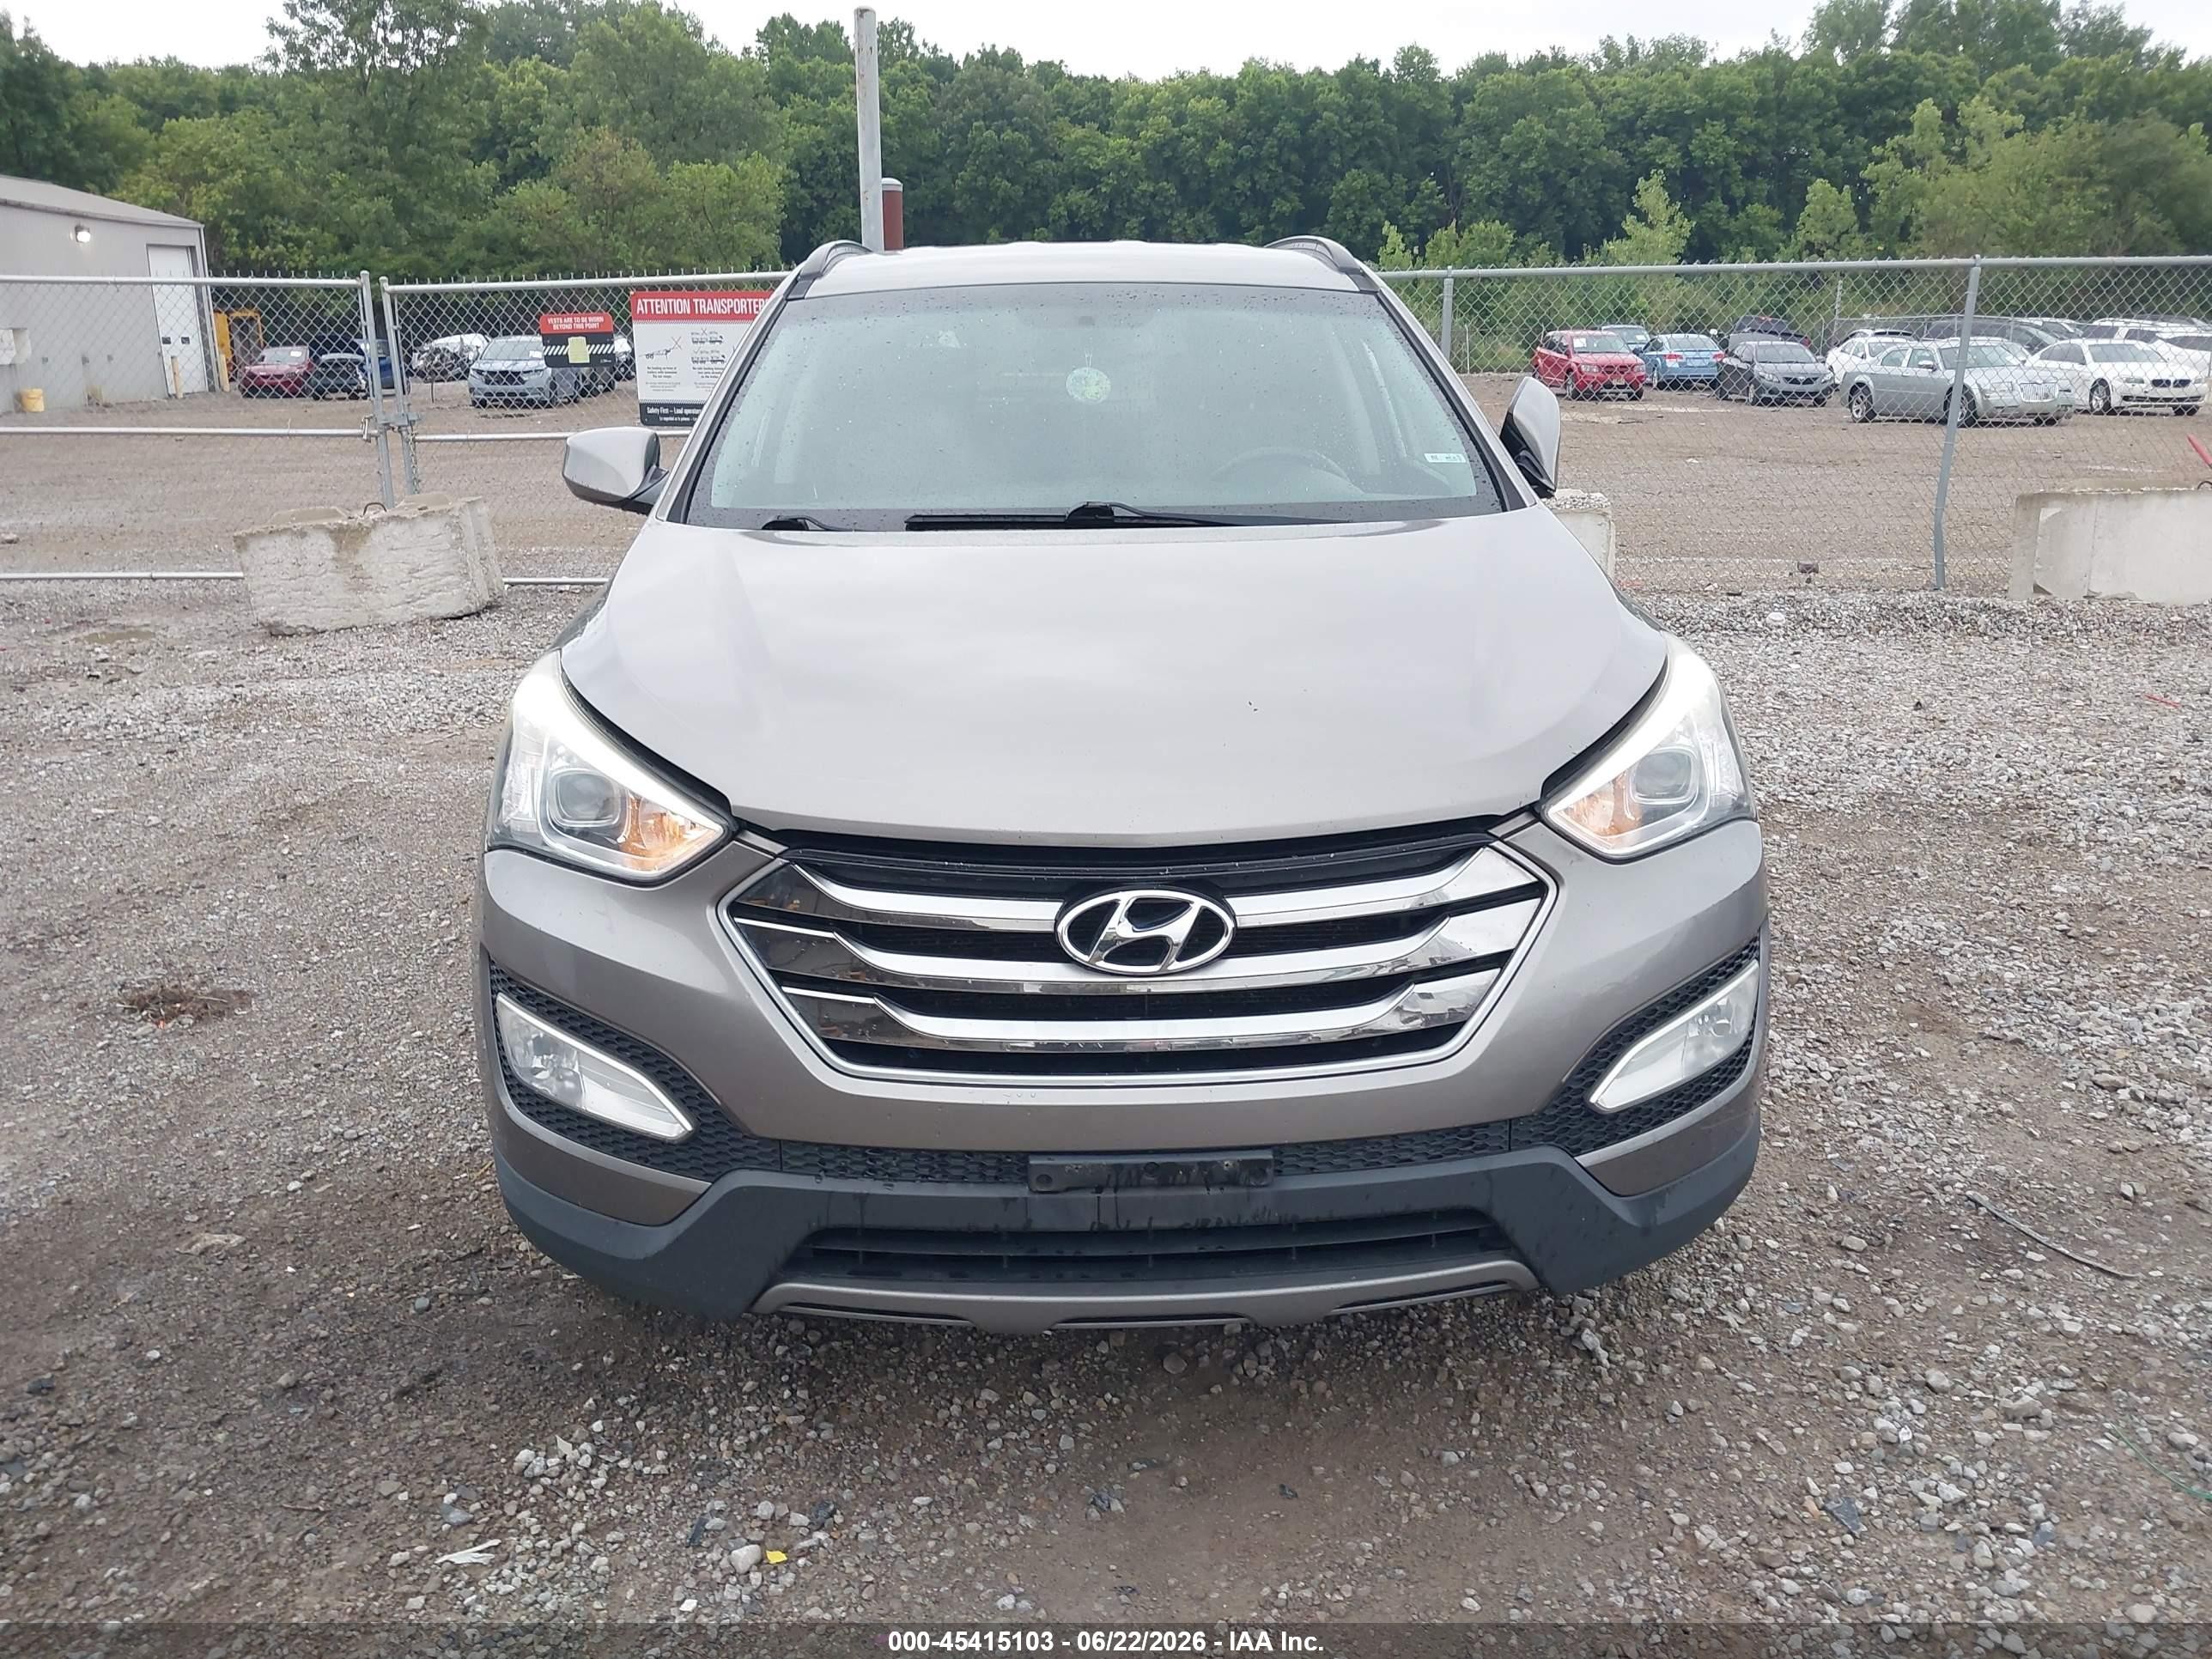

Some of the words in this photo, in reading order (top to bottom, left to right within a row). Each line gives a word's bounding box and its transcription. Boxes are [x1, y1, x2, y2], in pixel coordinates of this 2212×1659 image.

[636, 298, 690, 314] ATTENTION
[693, 298, 769, 314] TRANSPORTER
[647, 406, 660, 416] Safety
